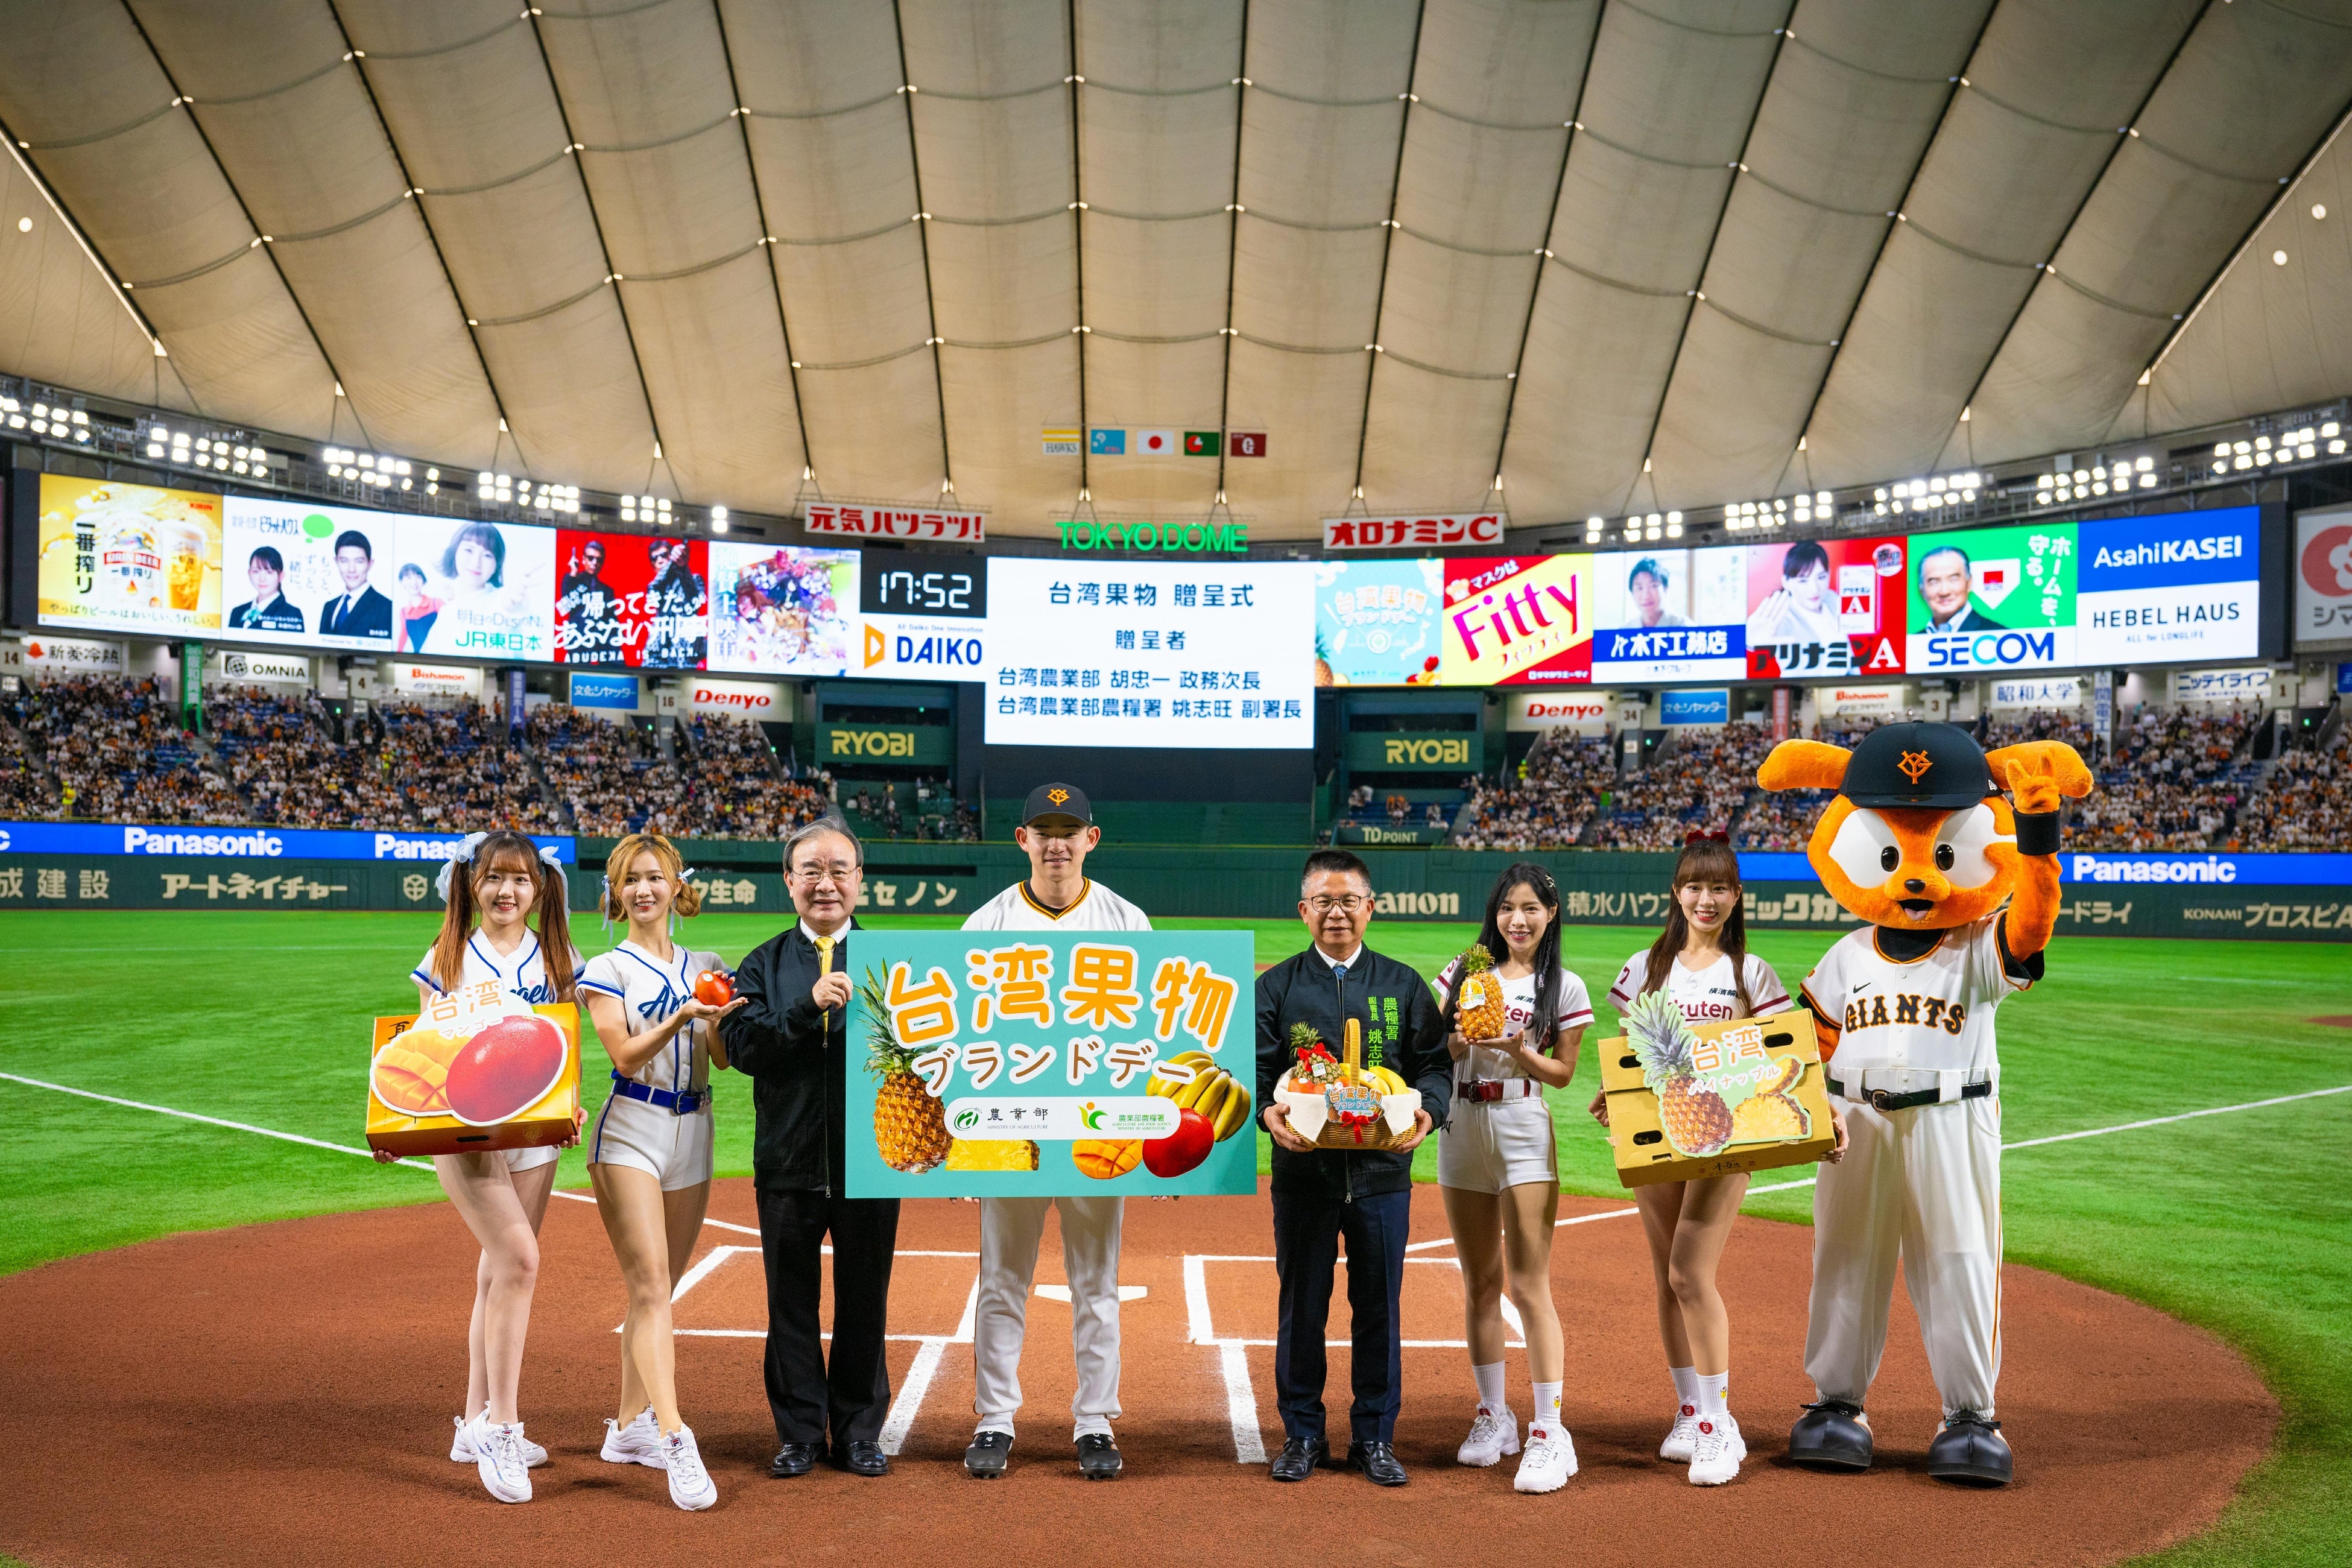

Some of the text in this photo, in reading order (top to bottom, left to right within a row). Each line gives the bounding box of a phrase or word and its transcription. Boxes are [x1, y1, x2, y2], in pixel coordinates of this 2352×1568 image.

[1046, 443, 1077, 454] HAWKS
[809, 505, 982, 540] 元気ハツラツ!
[1329, 516, 1498, 547] オロナミンC
[1055, 522, 1248, 552] TOKYO DOME
[76, 522, 96, 594] 一番搾り
[2025, 534, 2050, 587] 守る。
[1470, 558, 1520, 589] マスクは
[2040, 536, 2072, 627] ホームを、
[880, 571, 972, 609] 17:52
[1049, 582, 1254, 607] 台湾果物 贈呈式
[582, 590, 684, 619] 帰ってきた
[1452, 573, 1578, 662] Fitty
[2093, 602, 2240, 628] HEBEL HAUS
[456, 631, 542, 651] JR東日本
[897, 636, 982, 665] DAIKO
[1116, 630, 1186, 650] 贈呈者
[1629, 630, 1728, 657] 木下工務店
[1928, 632, 2054, 666] SECOM
[253, 664, 306, 678] OMNIA
[358, 678, 365, 689] 4
[997, 667, 1261, 691] 台湾農業部 胡忠一 政務次長
[694, 689, 771, 710] Denyo
[1997, 683, 2073, 703] 昭和大学
[2280, 683, 2286, 698] 1
[997, 695, 1302, 719] 台湾農業部農糧署 姚志旺 副署長
[1527, 703, 1604, 719] Denyo
[1931, 700, 1939, 712] 3
[831, 730, 915, 757] RYOBI
[1385, 739, 1469, 764] RYOBI
[124, 826, 283, 857] Panasonic
[1361, 827, 1418, 843] TD POINT
[2073, 855, 2237, 883] Panasonic
[160, 871, 349, 900] アートネイチャー
[1371, 890, 1459, 915] anon
[2183, 908, 2242, 921] KONAMI
[430, 979, 502, 1022] 台湾
[888, 945, 1235, 1049] 台湾果物
[1668, 999, 1734, 1020] kuten
[441, 1019, 501, 1037] マンゴー
[1383, 997, 1399, 1040] 農糧署
[1844, 993, 1966, 1036] GIANTS
[1692, 1028, 1763, 1071] 台湾
[916, 1040, 1195, 1091] ブランドデー
[1690, 1066, 1780, 1093] パイナップル
[1329, 1087, 1383, 1104] 台湾果物
